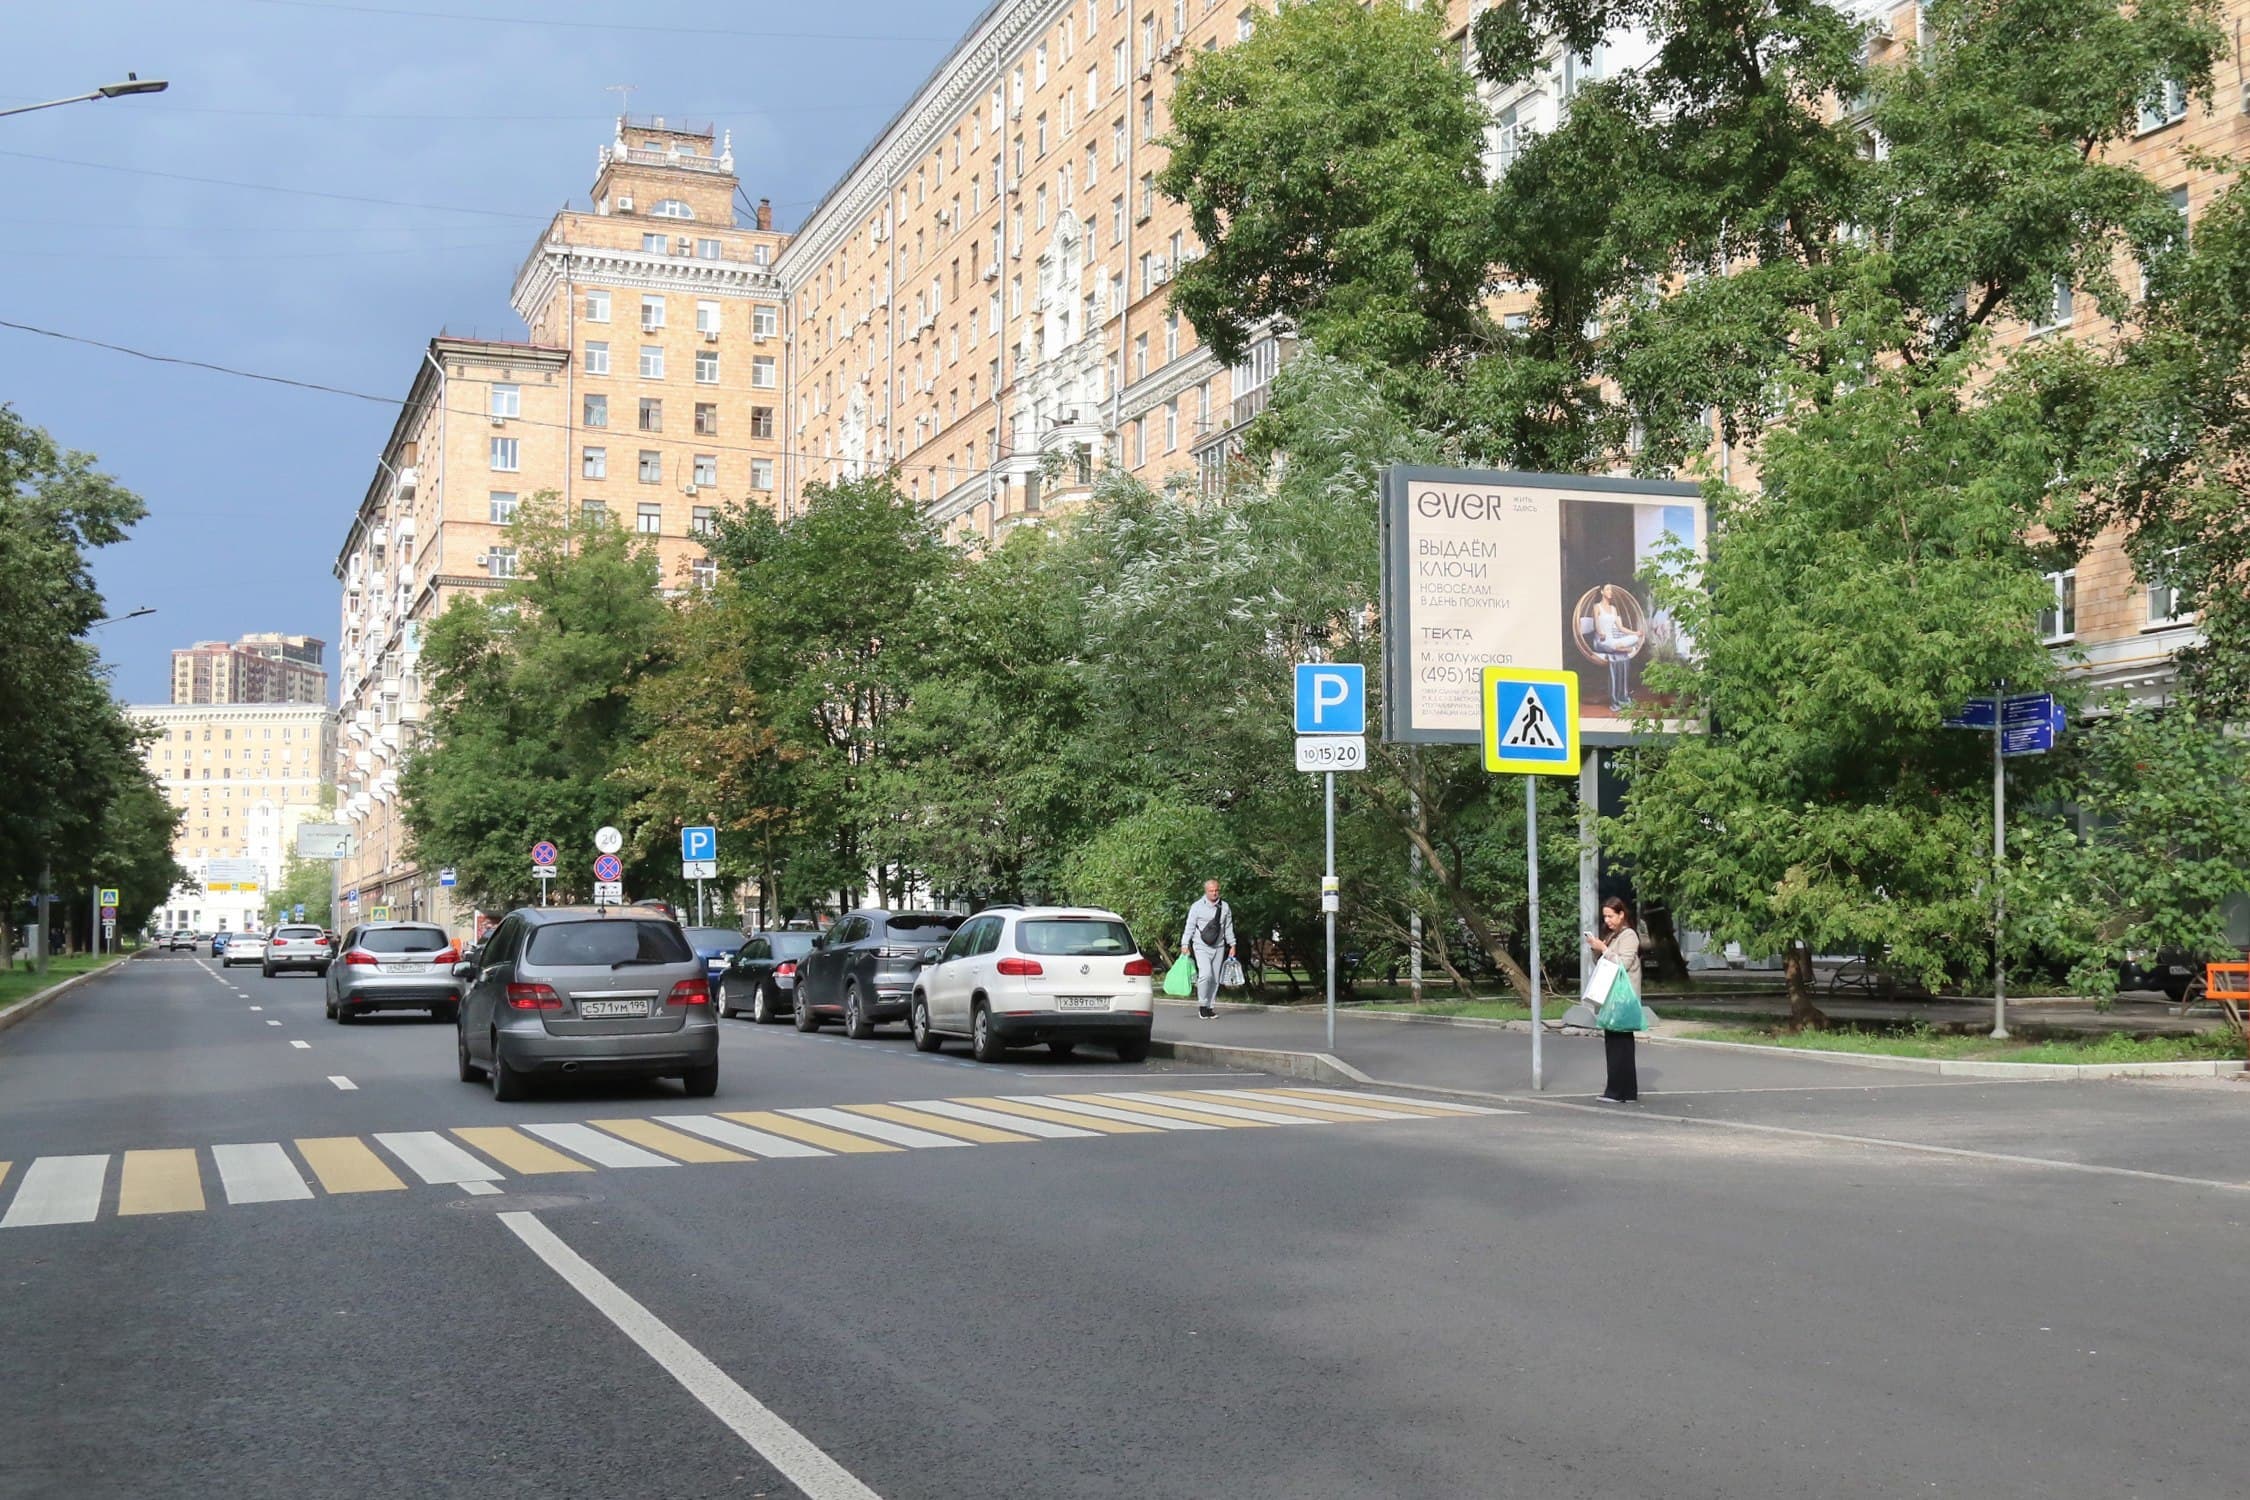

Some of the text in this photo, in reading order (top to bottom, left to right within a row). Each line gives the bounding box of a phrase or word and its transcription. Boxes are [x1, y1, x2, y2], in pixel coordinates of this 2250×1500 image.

[1419, 538, 1497, 559] ВЫДАЁМ
[1419, 560, 1487, 579] КЛЮЧИ
[1421, 595, 1510, 609] В ДЕНЬ ПОКУПКИ
[1421, 627, 1473, 640] ТЕКТА
[1421, 666, 1480, 683] (495)15
[1313, 673, 1349, 724] P
[1304, 746, 1356, 761] 10 15 20
[691, 831, 708, 857] P
